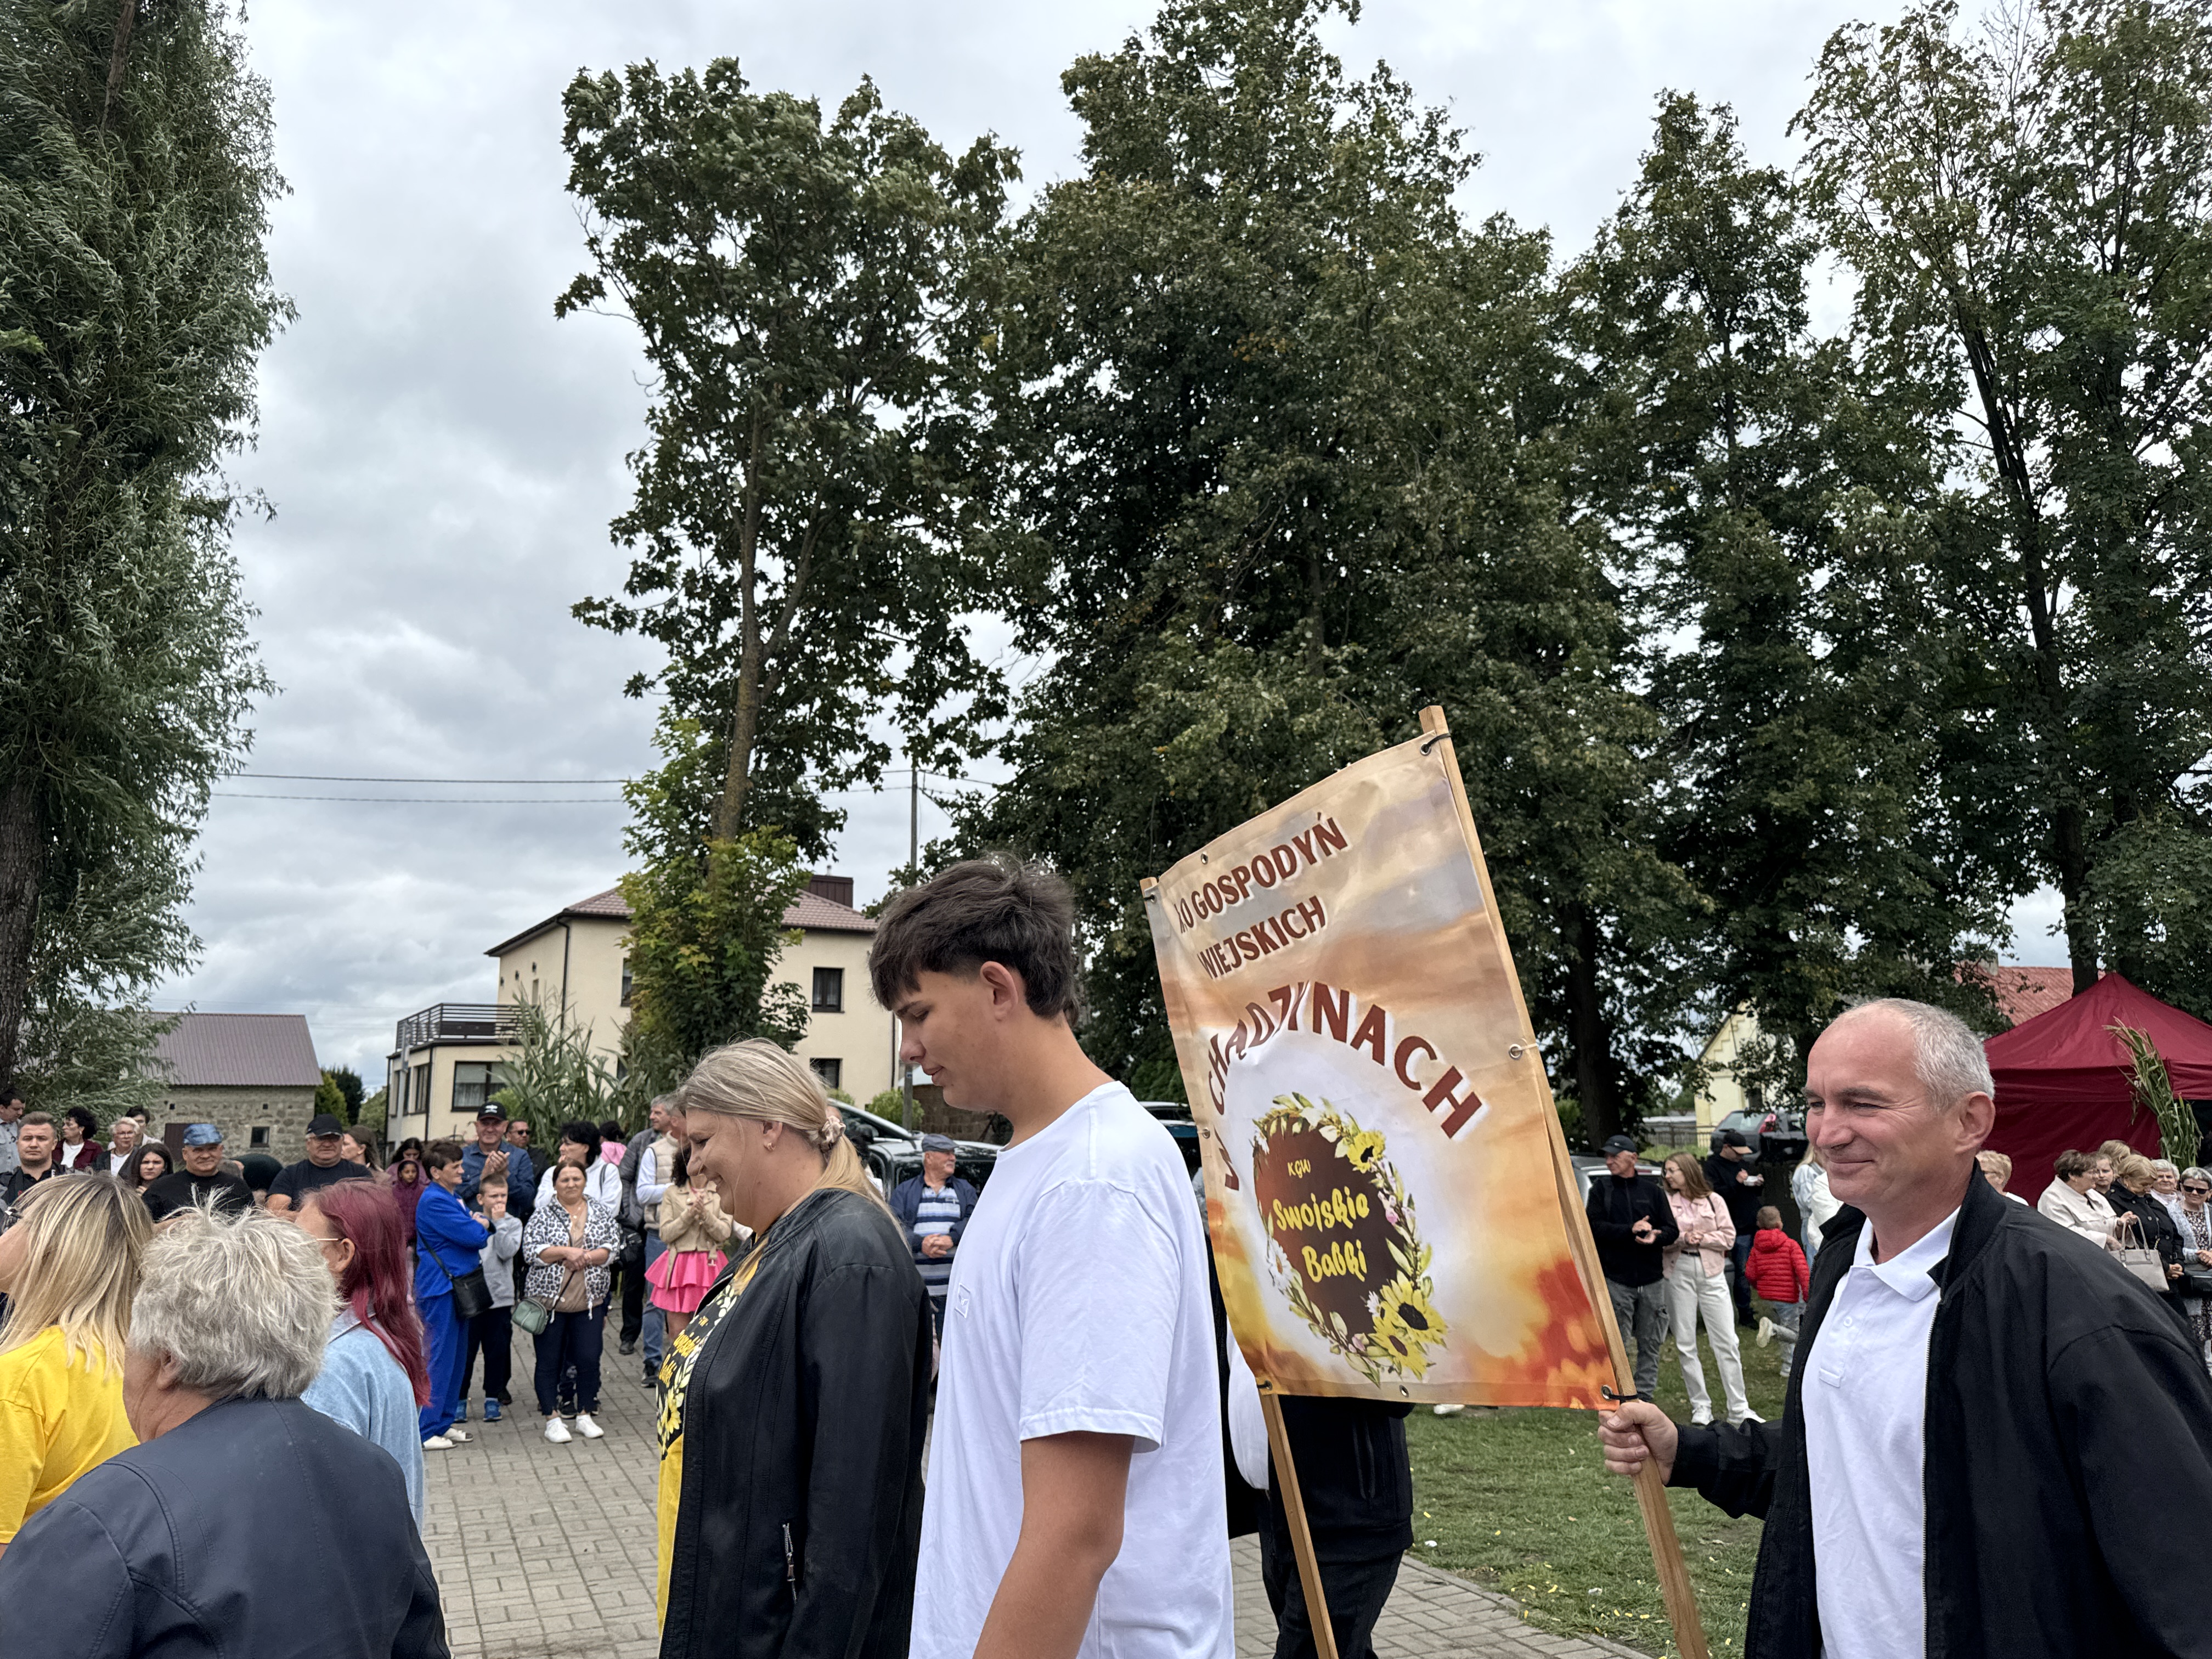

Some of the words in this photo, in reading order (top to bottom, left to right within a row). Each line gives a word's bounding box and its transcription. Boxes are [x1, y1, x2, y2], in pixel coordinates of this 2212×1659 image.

[1191, 812, 1348, 919] GOSPODYŃ
[1197, 895, 1326, 980] WIEJSKICH
[1287, 1159, 1311, 1178] KGW
[1273, 1186, 1370, 1232] Swojskie
[1301, 1239, 1368, 1283] Babki
